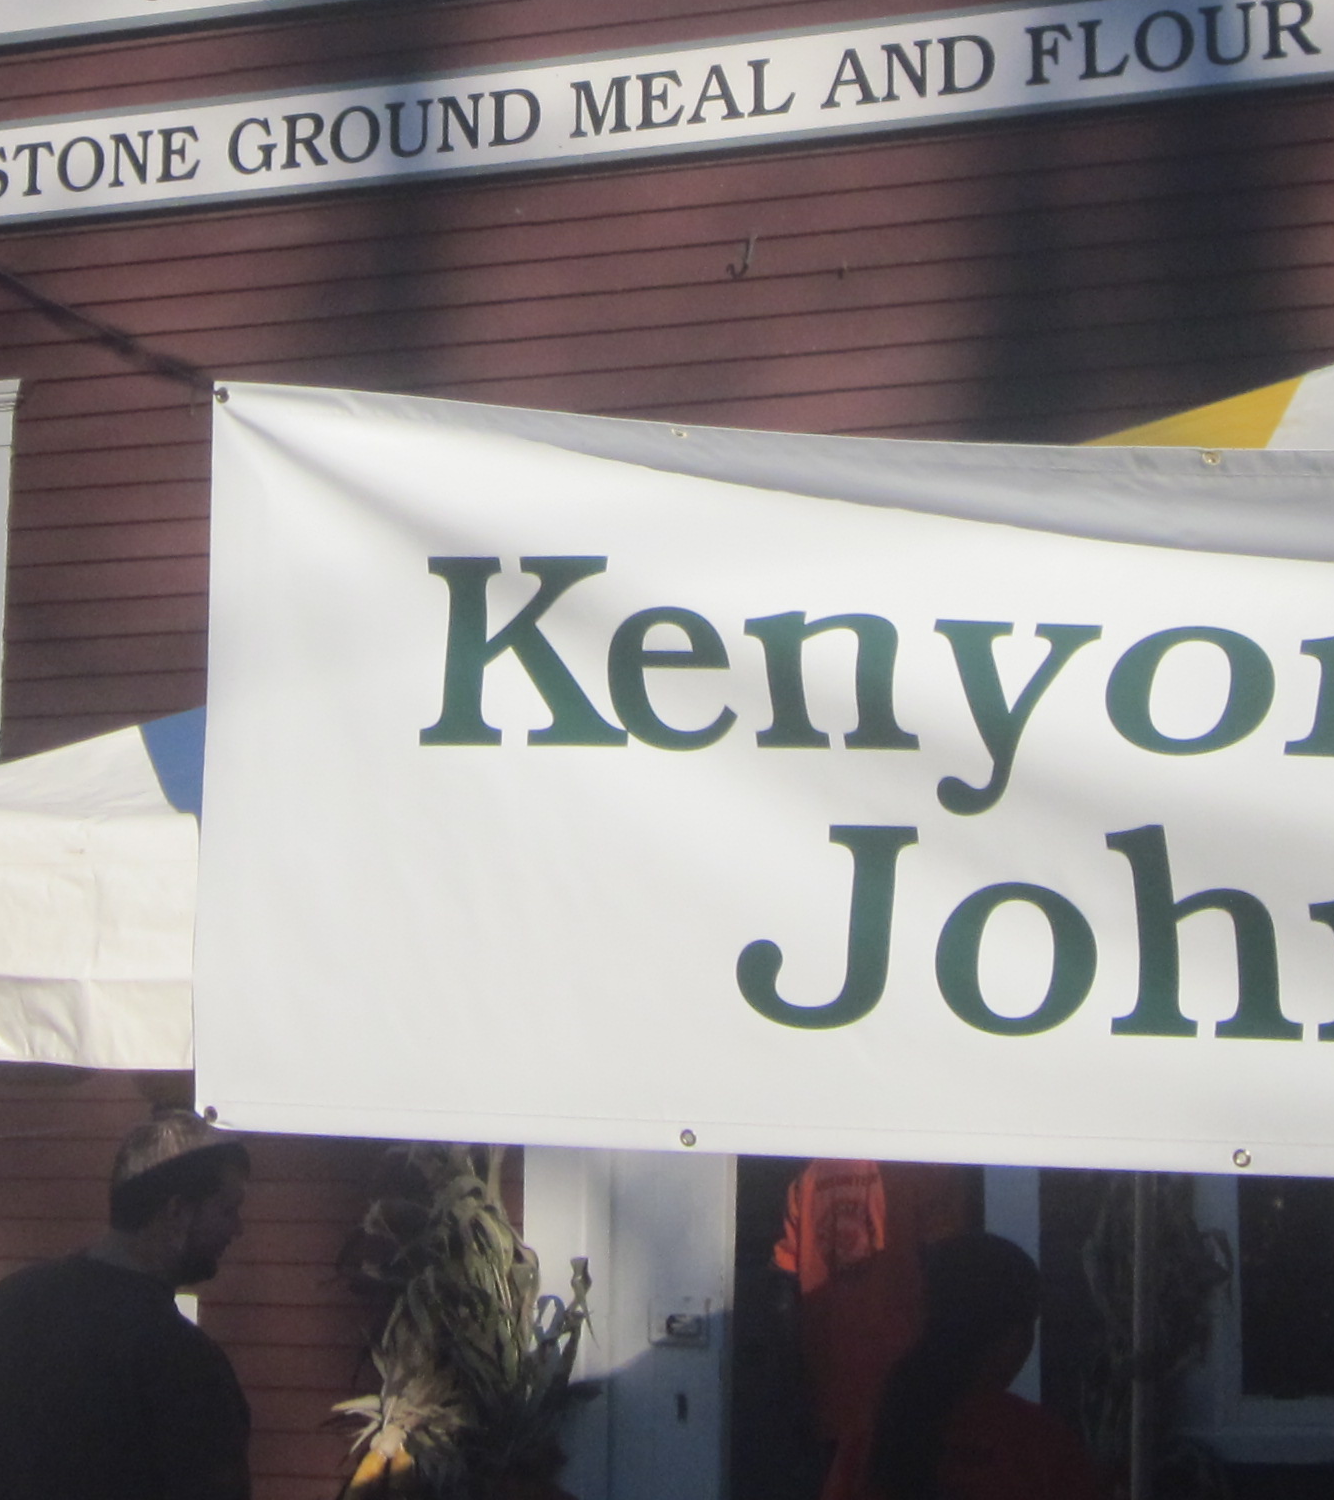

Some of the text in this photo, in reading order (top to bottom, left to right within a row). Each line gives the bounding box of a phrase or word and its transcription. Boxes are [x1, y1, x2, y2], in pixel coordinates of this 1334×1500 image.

[226, 87, 542, 176] GROUND
[569, 58, 796, 140] MEAL
[820, 33, 996, 109] AND
